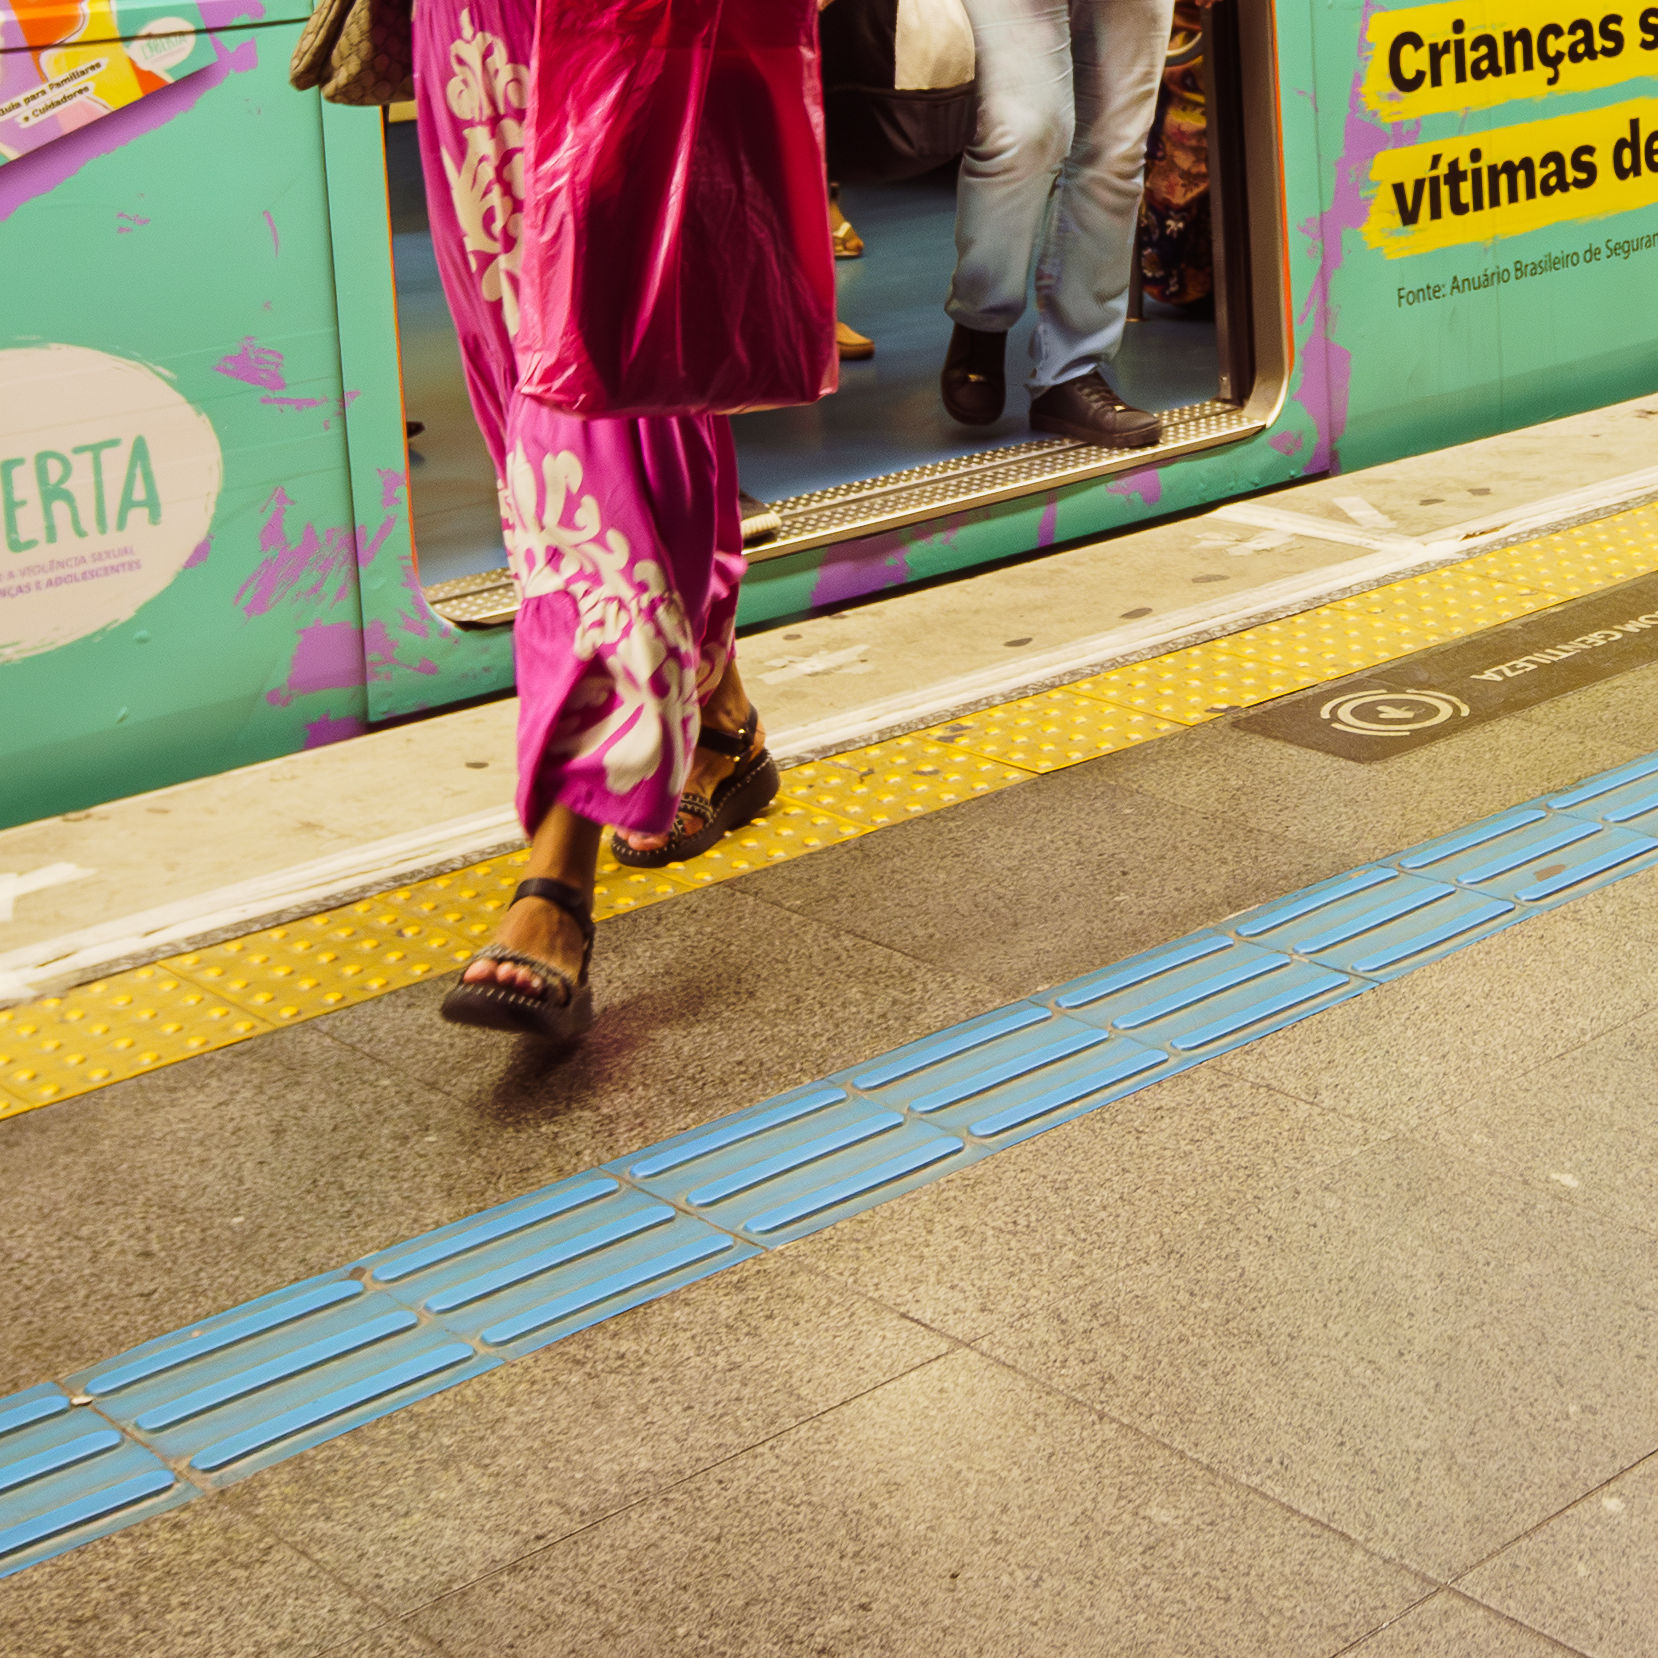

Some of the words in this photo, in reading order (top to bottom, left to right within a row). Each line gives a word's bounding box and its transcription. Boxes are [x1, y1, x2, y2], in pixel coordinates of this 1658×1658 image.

[1388, 11, 1624, 92] Crianças
[23, 89, 46, 105] para
[49, 62, 101, 90] Familiares
[32, 85, 89, 117] Cuidadores
[1392, 143, 1596, 227] vítimas
[1397, 285, 1446, 308] Fonte:
[1450, 269, 1510, 296] Anuário
[1514, 251, 1579, 280] Brasileiro
[1583, 244, 1601, 263] de
[19, 556, 87, 578] VIOLÊNCIA
[91, 546, 135, 562] SEXUAL
[45, 559, 141, 589] ADOLESCENTES
[1470, 630, 1623, 683] GENTILEZA
